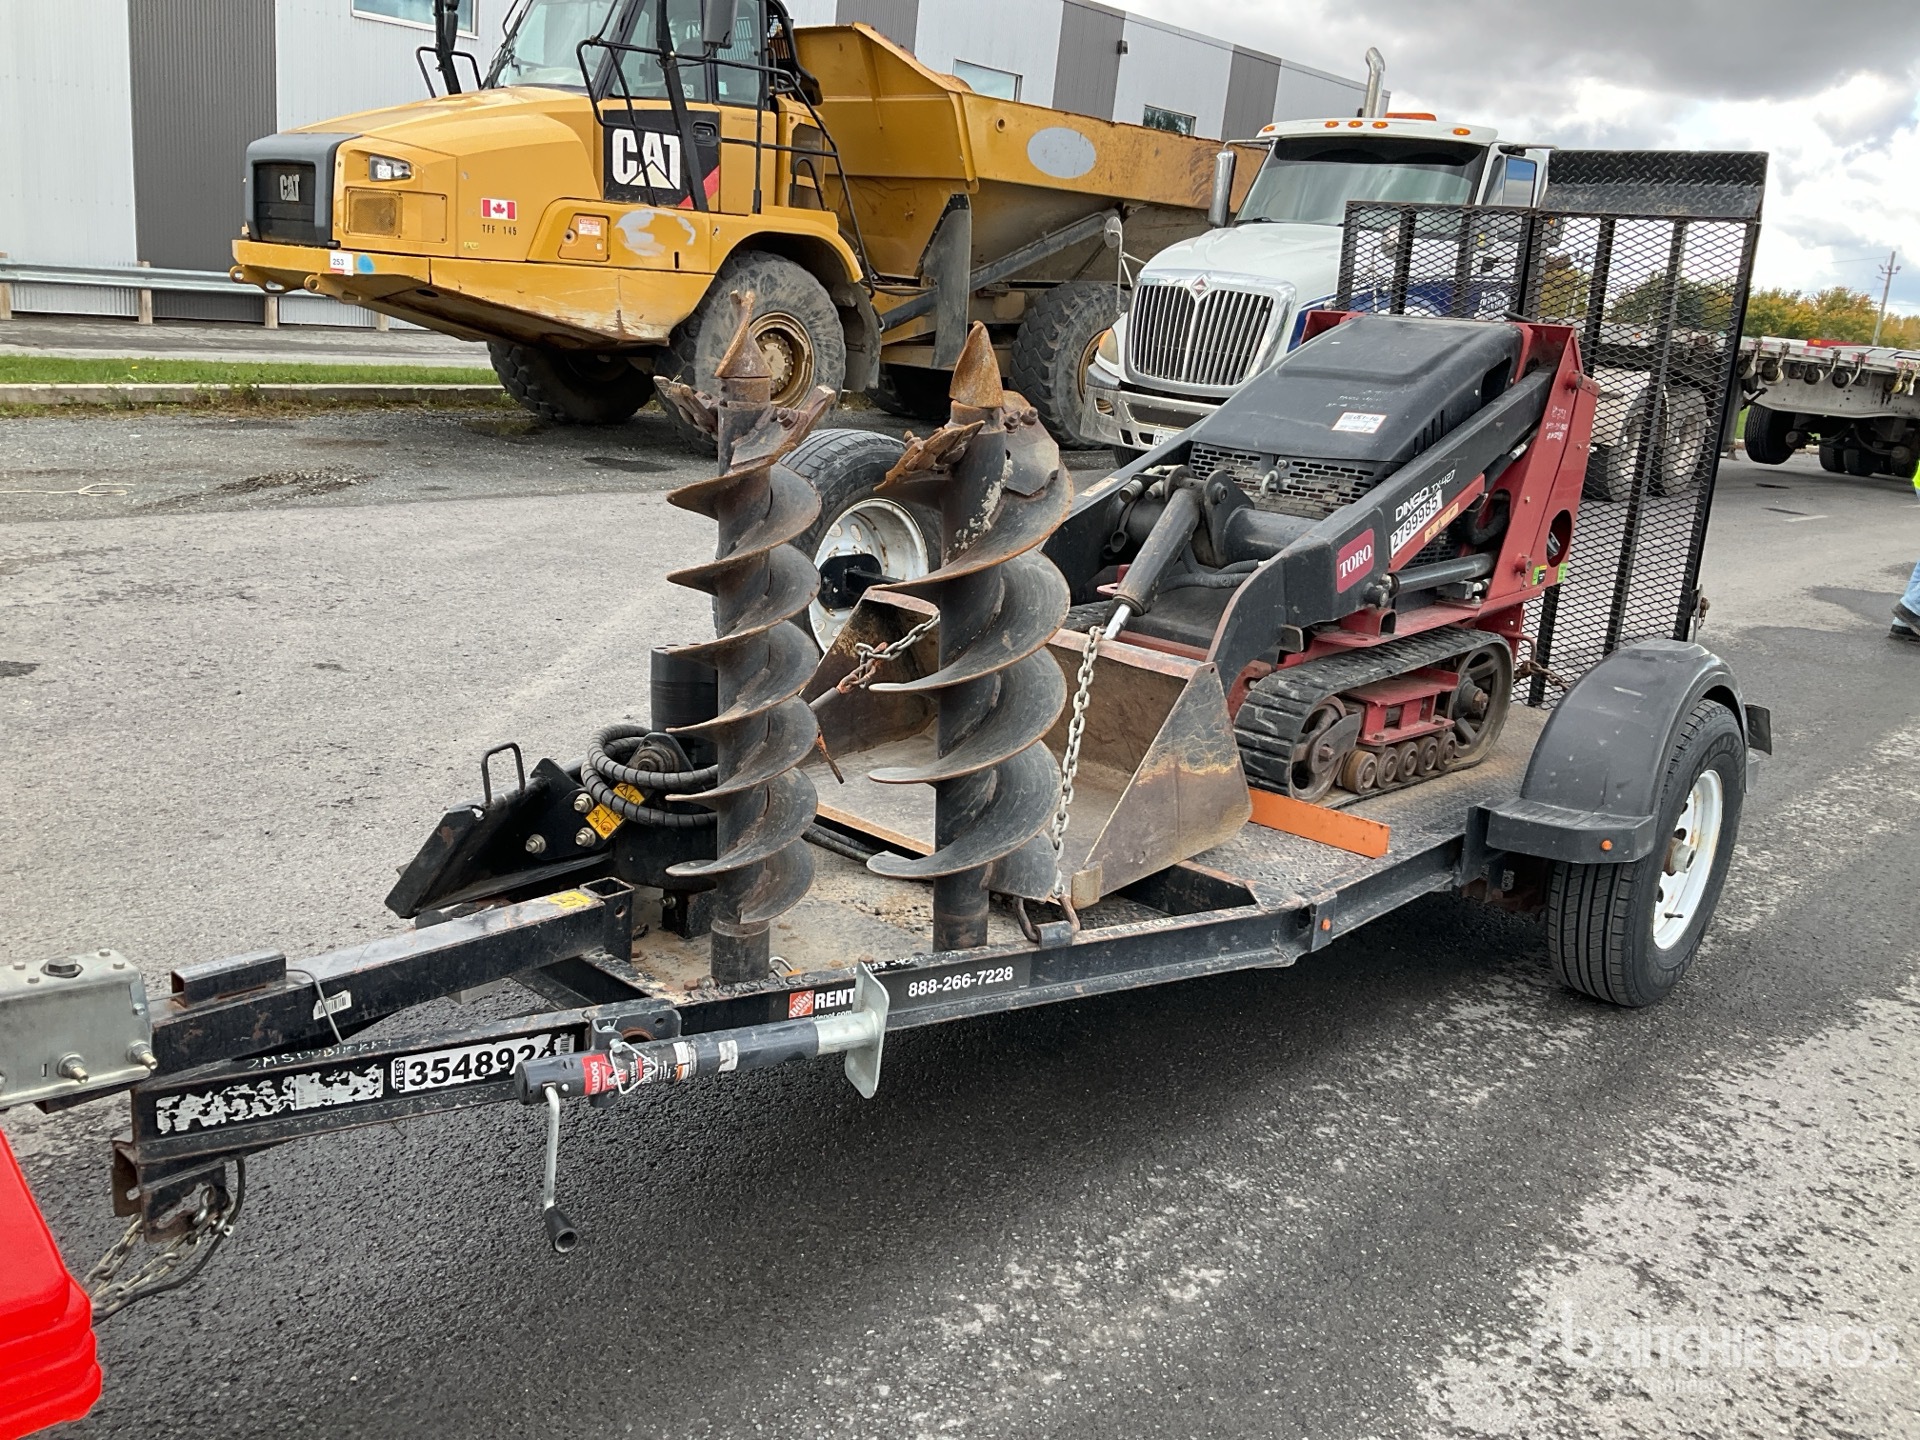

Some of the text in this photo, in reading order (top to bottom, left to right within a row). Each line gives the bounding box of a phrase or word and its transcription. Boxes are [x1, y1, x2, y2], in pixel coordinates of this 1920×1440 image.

[612, 128, 681, 190] CAT
[280, 174, 300, 202] CAT
[1395, 486, 1431, 522] DINGO
[1392, 496, 1439, 550] 2799985
[1339, 544, 1372, 579] TORO
[908, 966, 1014, 998] 888-266-7228
[590, 1061, 600, 1095] ULLDOG
